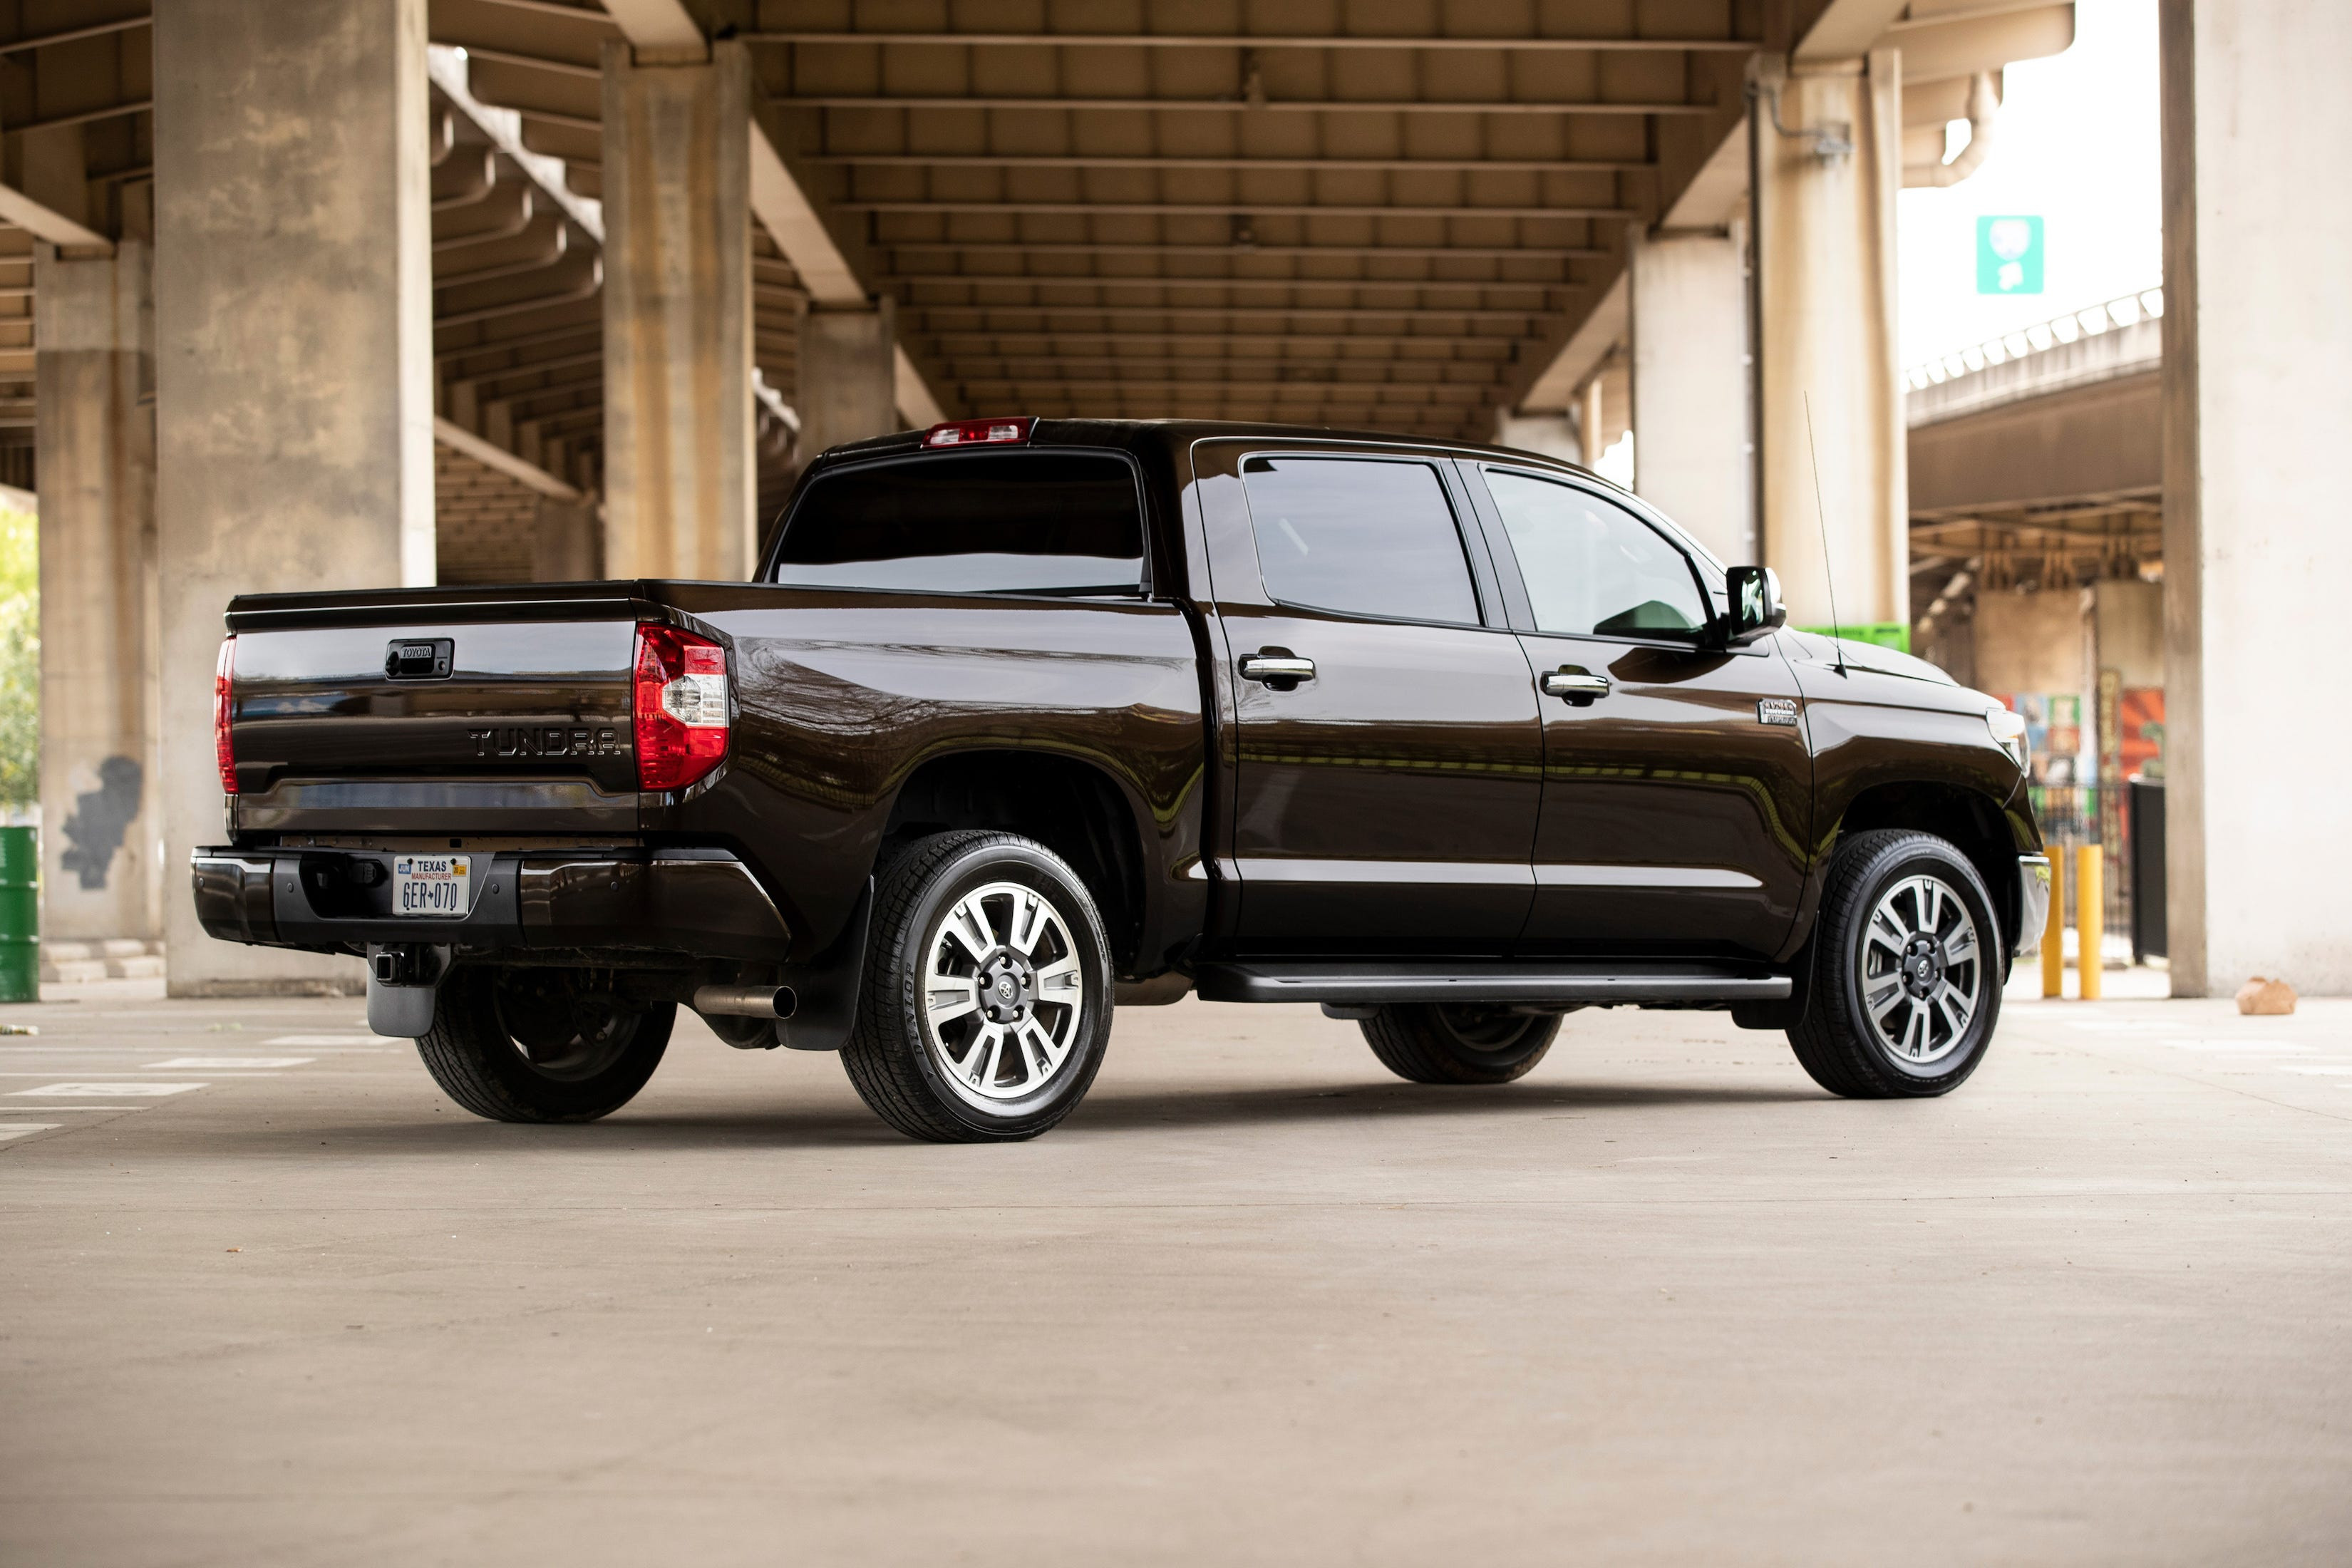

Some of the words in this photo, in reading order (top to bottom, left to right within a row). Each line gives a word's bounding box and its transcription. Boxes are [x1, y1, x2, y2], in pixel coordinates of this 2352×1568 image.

[402, 647, 431, 659] TOYOTA
[469, 729, 621, 756] TUNDRA
[418, 861, 446, 872] TEXAS
[904, 963, 924, 1057] DUNLOP
